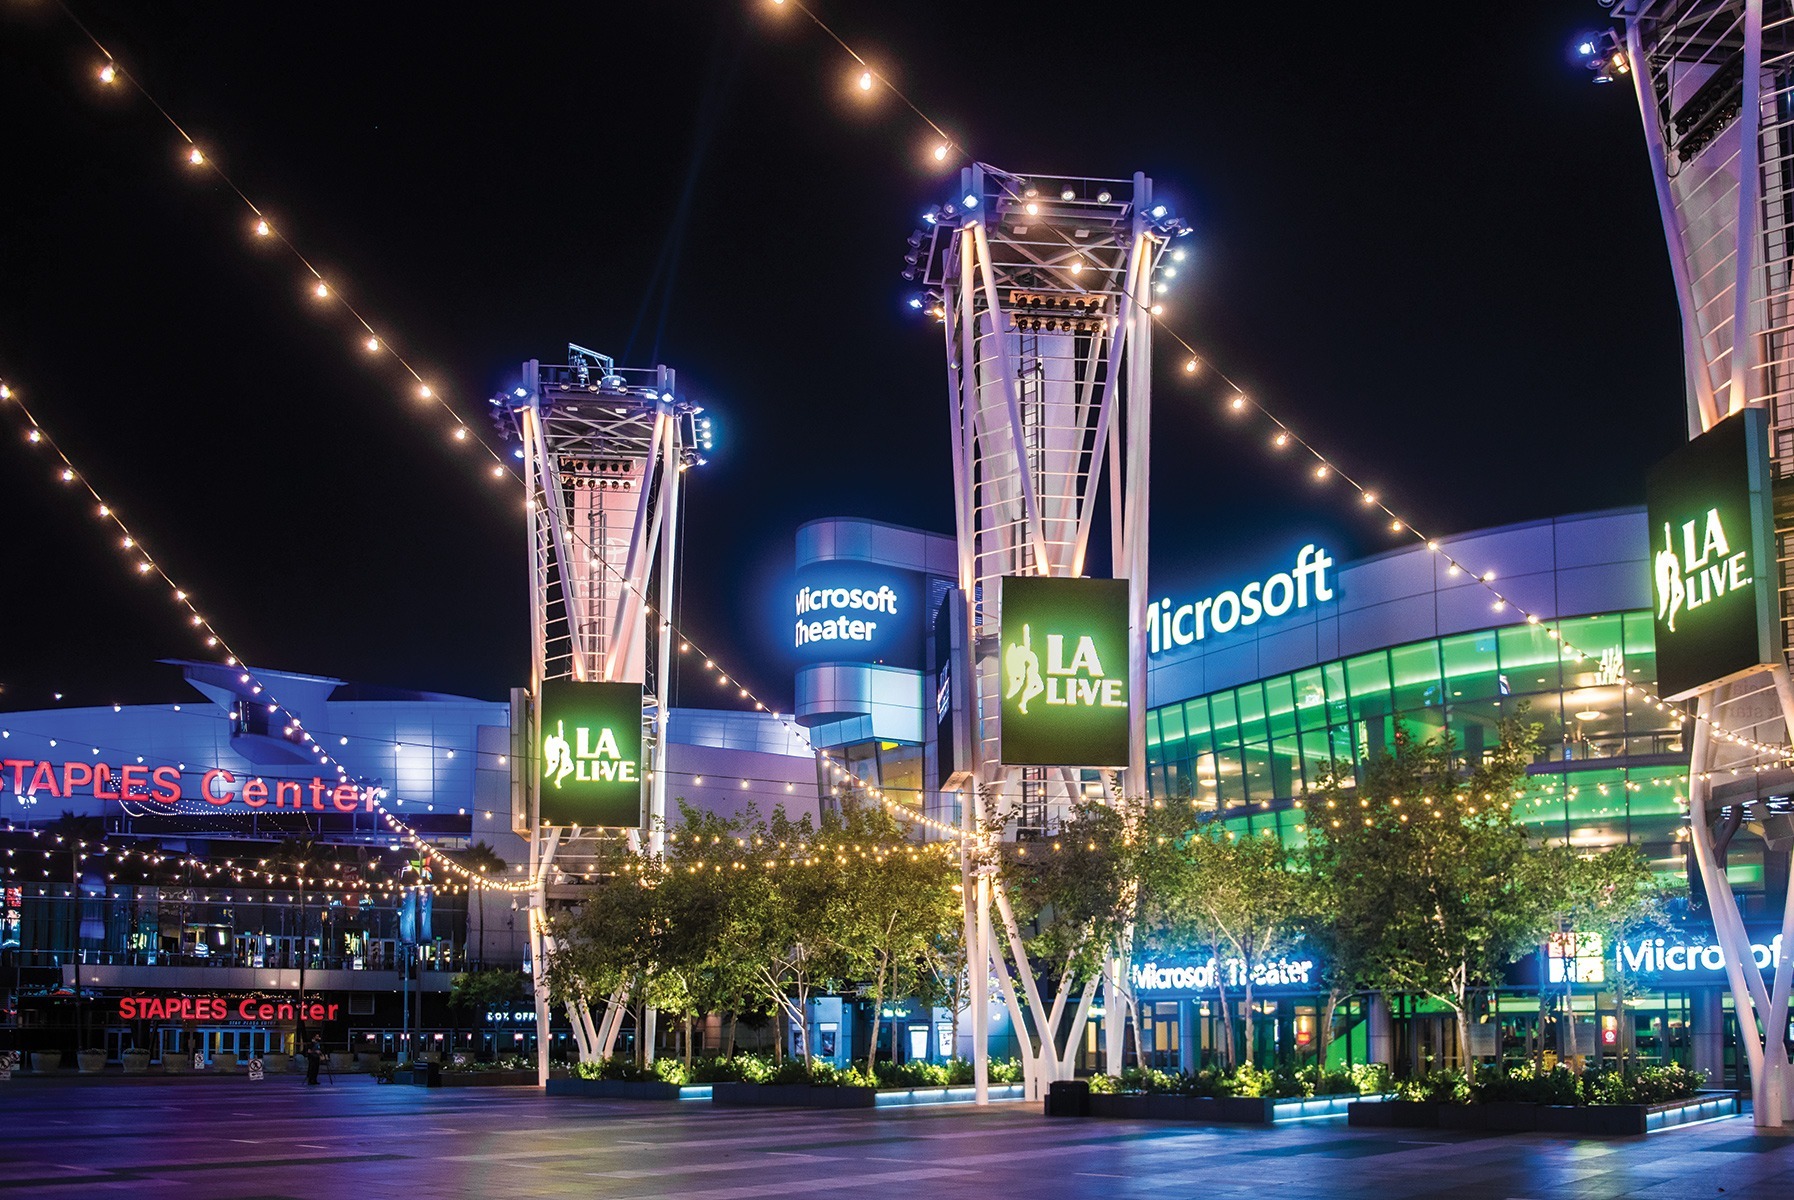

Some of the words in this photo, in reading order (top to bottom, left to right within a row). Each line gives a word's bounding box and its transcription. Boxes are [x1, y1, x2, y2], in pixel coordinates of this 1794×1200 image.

[1681, 507, 1731, 574] LA
[1046, 634, 1105, 677] LA
[576, 727, 622, 760] LA
[0, 758, 183, 804] TAPLES
[201, 769, 384, 813] Center
[1615, 933, 1794, 973] Microof
[118, 997, 228, 1022] STAPLES
[238, 999, 339, 1022] Center
